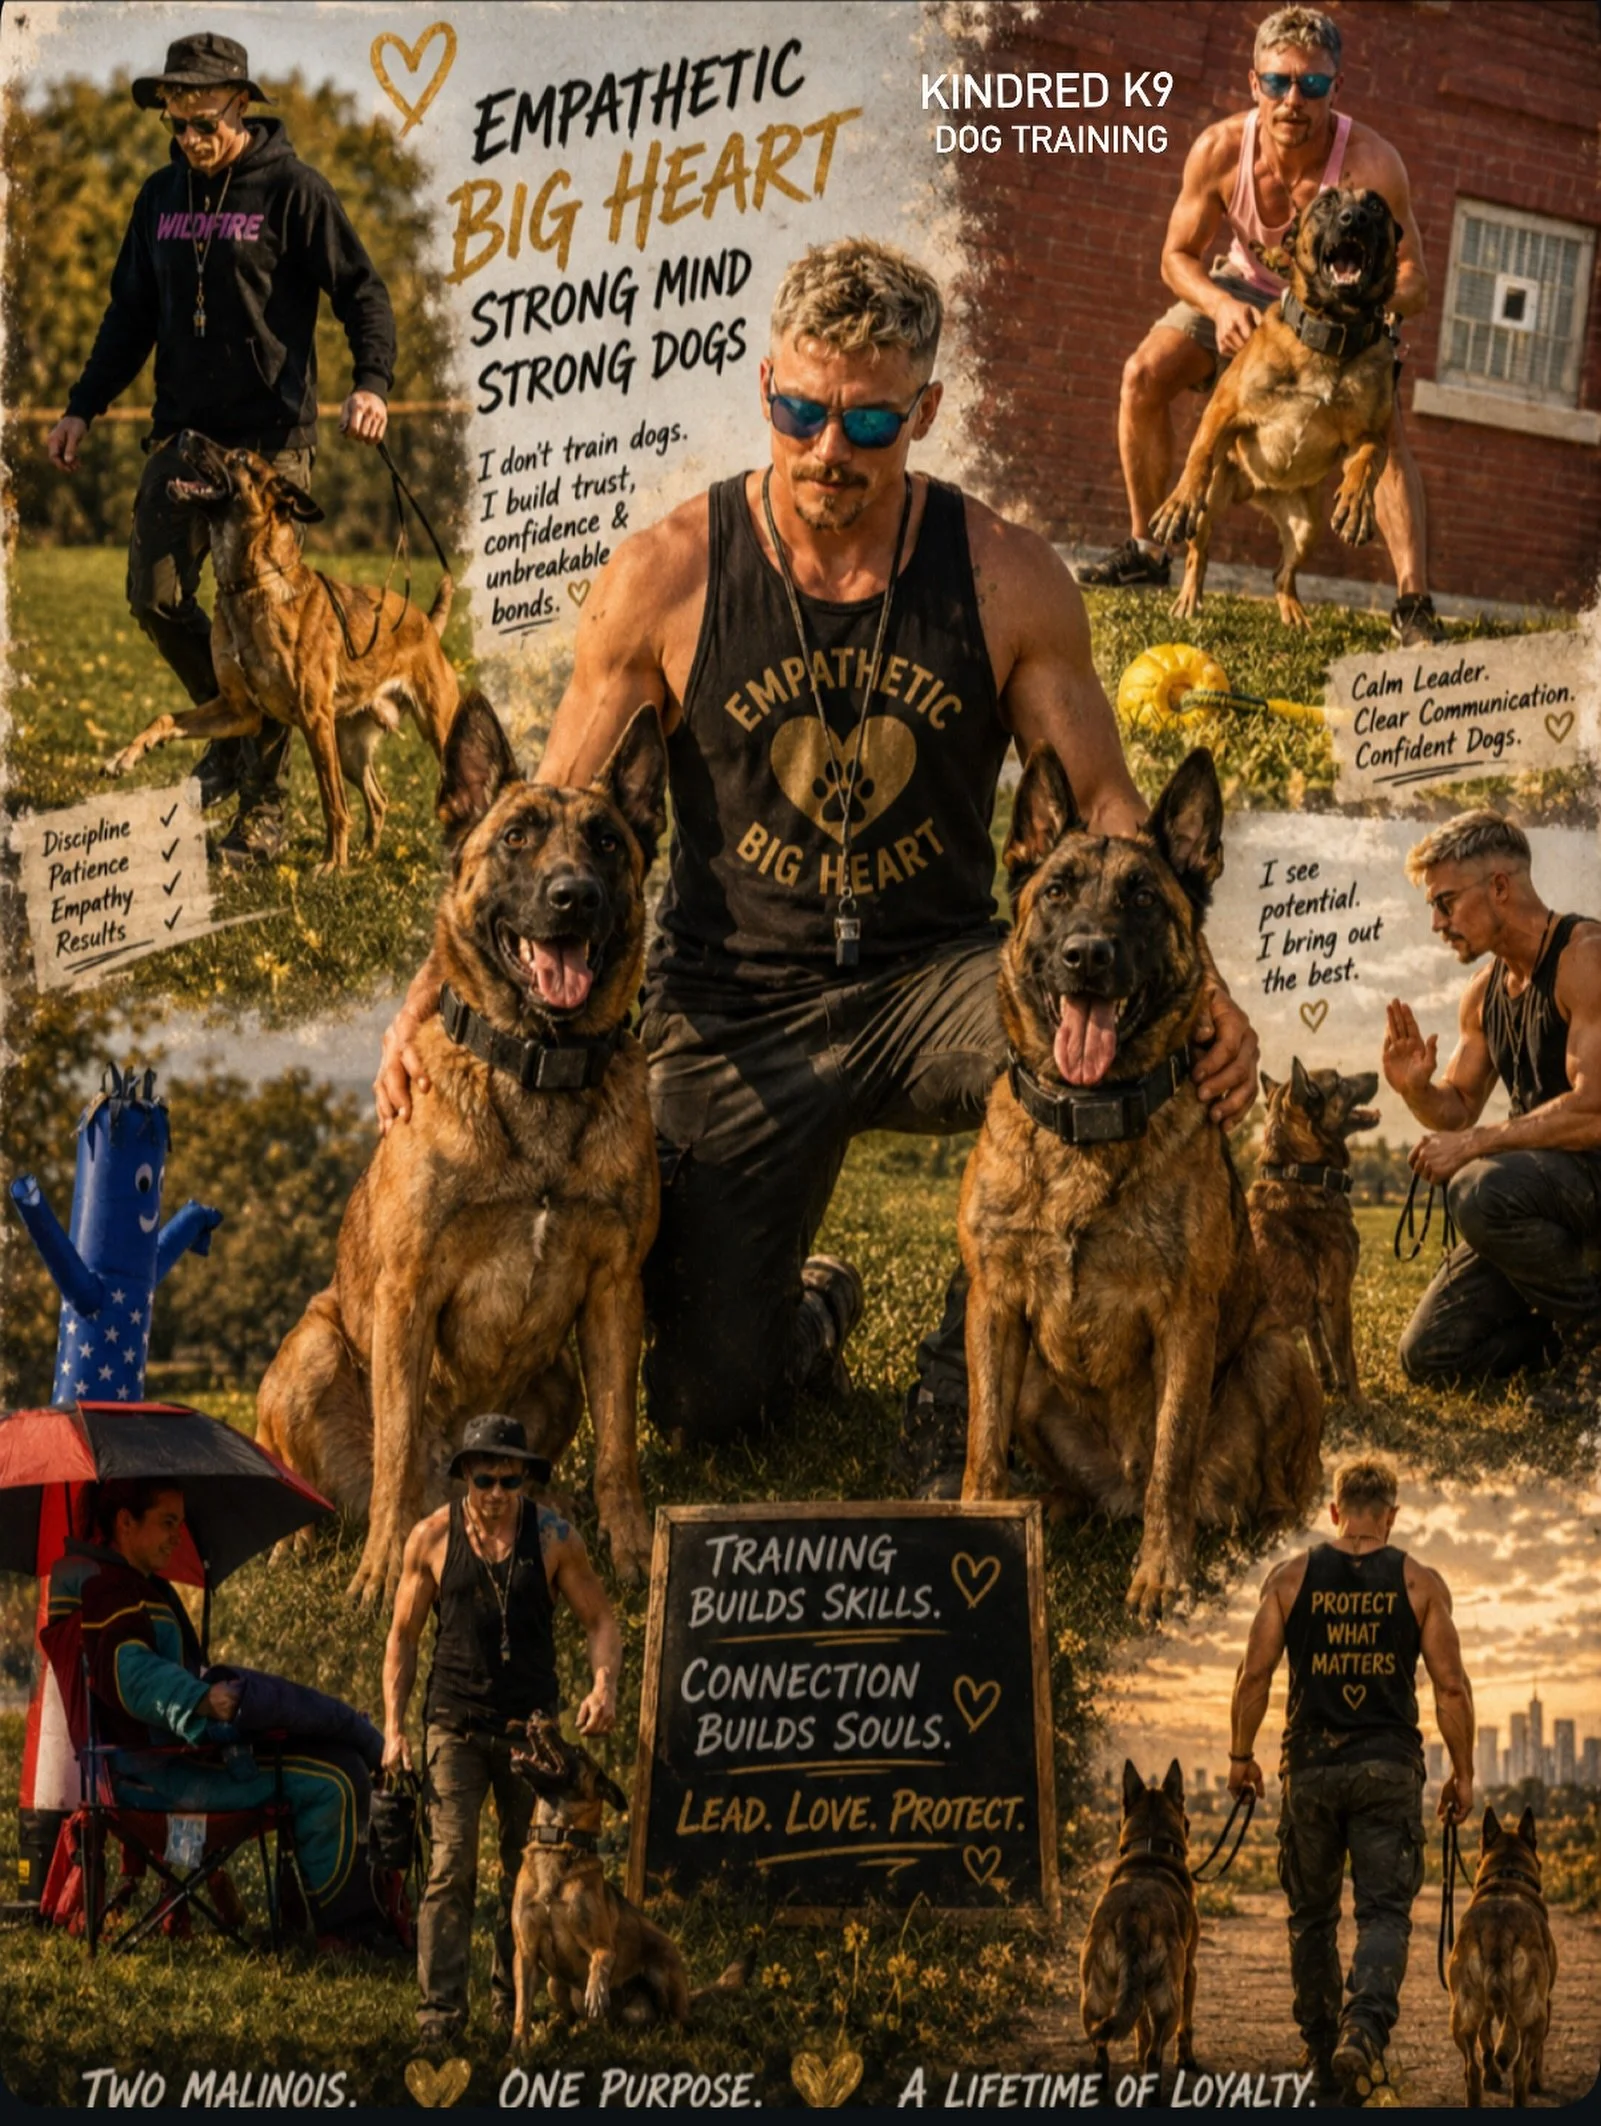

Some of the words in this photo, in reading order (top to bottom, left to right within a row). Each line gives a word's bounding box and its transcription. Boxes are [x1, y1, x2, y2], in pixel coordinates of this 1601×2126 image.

[471, 38, 805, 165] EMPATHETIC
[444, 168, 583, 286] BIG
[603, 107, 863, 252] HEART
[156, 212, 264, 241] WILDFIRE
[470, 266, 639, 347] STRONG
[653, 248, 752, 309] MIND
[476, 339, 637, 414] STRONG
[651, 318, 747, 380] DOGS
[477, 448, 496, 483] I
[500, 440, 553, 476] don't
[563, 432, 618, 465] train
[630, 419, 688, 456] dogs.
[480, 490, 498, 522] I
[506, 476, 561, 516] build
[571, 465, 636, 500] trust,
[484, 514, 600, 556] confidence
[611, 500, 629, 530] &
[486, 541, 611, 590] unbreakable
[492, 587, 560, 625] bonds.
[723, 647, 962, 733] EMPATHETIC
[1352, 669, 1403, 701] Calm
[1413, 658, 1490, 693] Leader.
[1353, 706, 1410, 736] Clear
[1419, 683, 1576, 726] Communication.
[1356, 730, 1457, 769] Confident
[1466, 726, 1522, 758] Dogs.
[41, 817, 131, 857] Discipline
[735, 821, 804, 887] BIG
[818, 817, 945, 896] HEART
[48, 855, 130, 891] Patience
[1258, 858, 1279, 890] I
[1285, 862, 1320, 884] see
[51, 885, 134, 925] Empathy
[1258, 880, 1360, 933] potential.
[55, 919, 127, 958] Results
[1256, 931, 1275, 962] I
[1282, 929, 1338, 959] bring
[1348, 916, 1384, 945] out
[1262, 965, 1297, 995] the
[1308, 956, 1359, 988] best.
[705, 1533, 898, 1578] TRAINING
[688, 1586, 805, 1629] BUILDS
[822, 1582, 941, 1622] SKILLS.
[1311, 1590, 1398, 1615] PROTECT
[1326, 1622, 1380, 1646] WHAT
[680, 1657, 921, 1703] CONNECTION
[1311, 1652, 1396, 1676] MATTERS
[694, 1712, 816, 1757] BUILDS
[833, 1711, 951, 1752] SOULS.
[675, 1789, 772, 1836] LEAD.
[785, 1790, 877, 1835] LOVE.
[889, 1788, 1025, 1835] PROTECT.
[82, 2068, 165, 2107] TWO
[181, 2068, 357, 2107] MALINOIS.
[499, 2068, 584, 2107] ONE
[599, 2068, 762, 2107] PURPOSE.
[898, 2067, 927, 2107] A
[944, 2071, 1100, 2107] LIFETIME
[1115, 2071, 1157, 2107] OF
[1171, 2067, 1317, 2107] LOYALTY.
